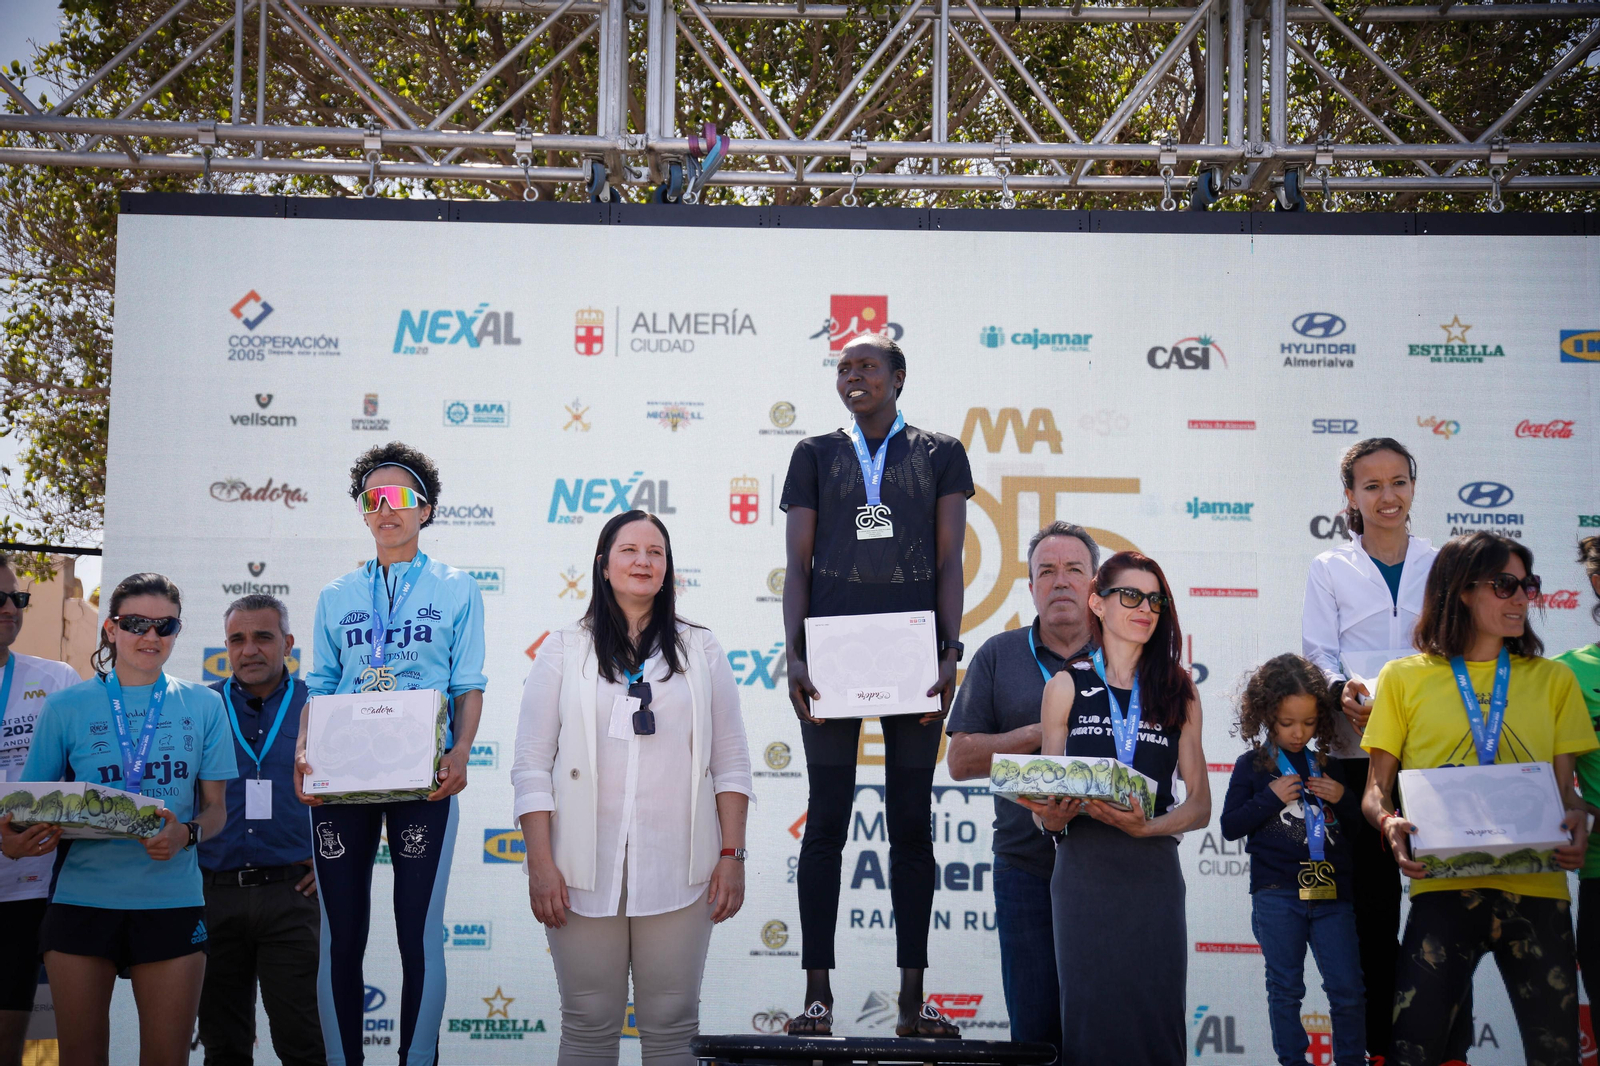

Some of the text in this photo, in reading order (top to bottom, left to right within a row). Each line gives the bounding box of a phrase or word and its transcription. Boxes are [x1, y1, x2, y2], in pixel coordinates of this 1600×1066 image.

[393, 304, 521, 353] NEXAL
[631, 308, 757, 335] ALMERÍA
[229, 334, 339, 350] COOPERACIÓN
[631, 338, 695, 353] CIUDAD
[1011, 328, 1093, 350] cajamar
[228, 349, 265, 361] 2005
[403, 347, 428, 355] 2020
[1280, 343, 1356, 354] HYUNDAI
[1408, 344, 1505, 356] ESTRELLA
[1147, 346, 1210, 370] CASI
[473, 404, 505, 413] SAFA
[230, 413, 297, 427] vellsam
[548, 471, 677, 523] NEXAL
[557, 515, 583, 524] 2020
[1447, 513, 1524, 525] HYUNDAI
[1078, 715, 1100, 724] CLUB
[97, 754, 190, 785] nrja
[454, 925, 486, 935] SAFA
[448, 1019, 546, 1033] ESTRELLA
